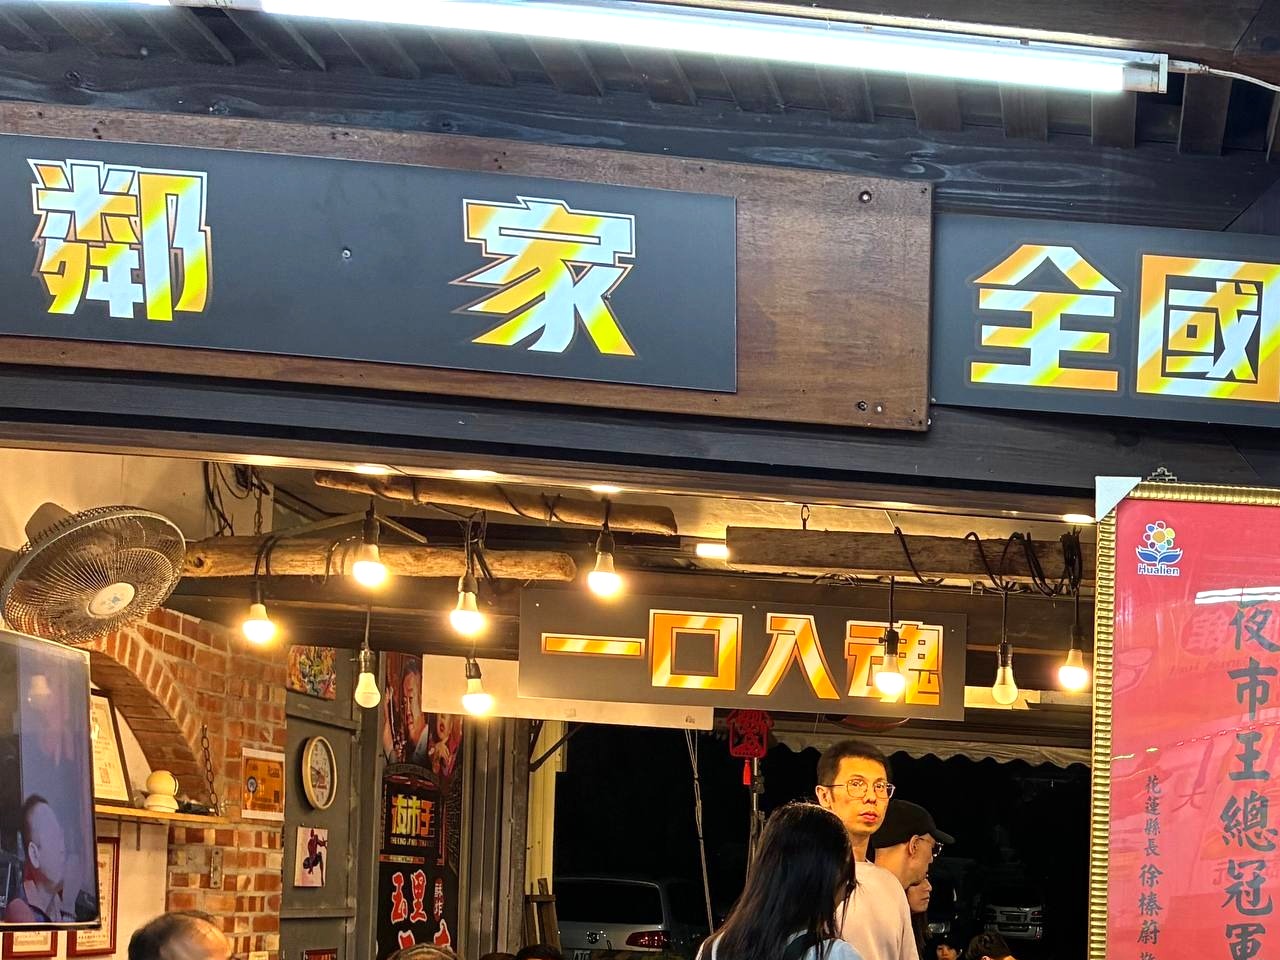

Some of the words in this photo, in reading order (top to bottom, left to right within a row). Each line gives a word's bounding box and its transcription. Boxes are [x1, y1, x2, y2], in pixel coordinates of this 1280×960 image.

[450, 196, 636, 357] 家
[1138, 564, 1180, 576] Hualien
[541, 609, 944, 705] 一口入魂
